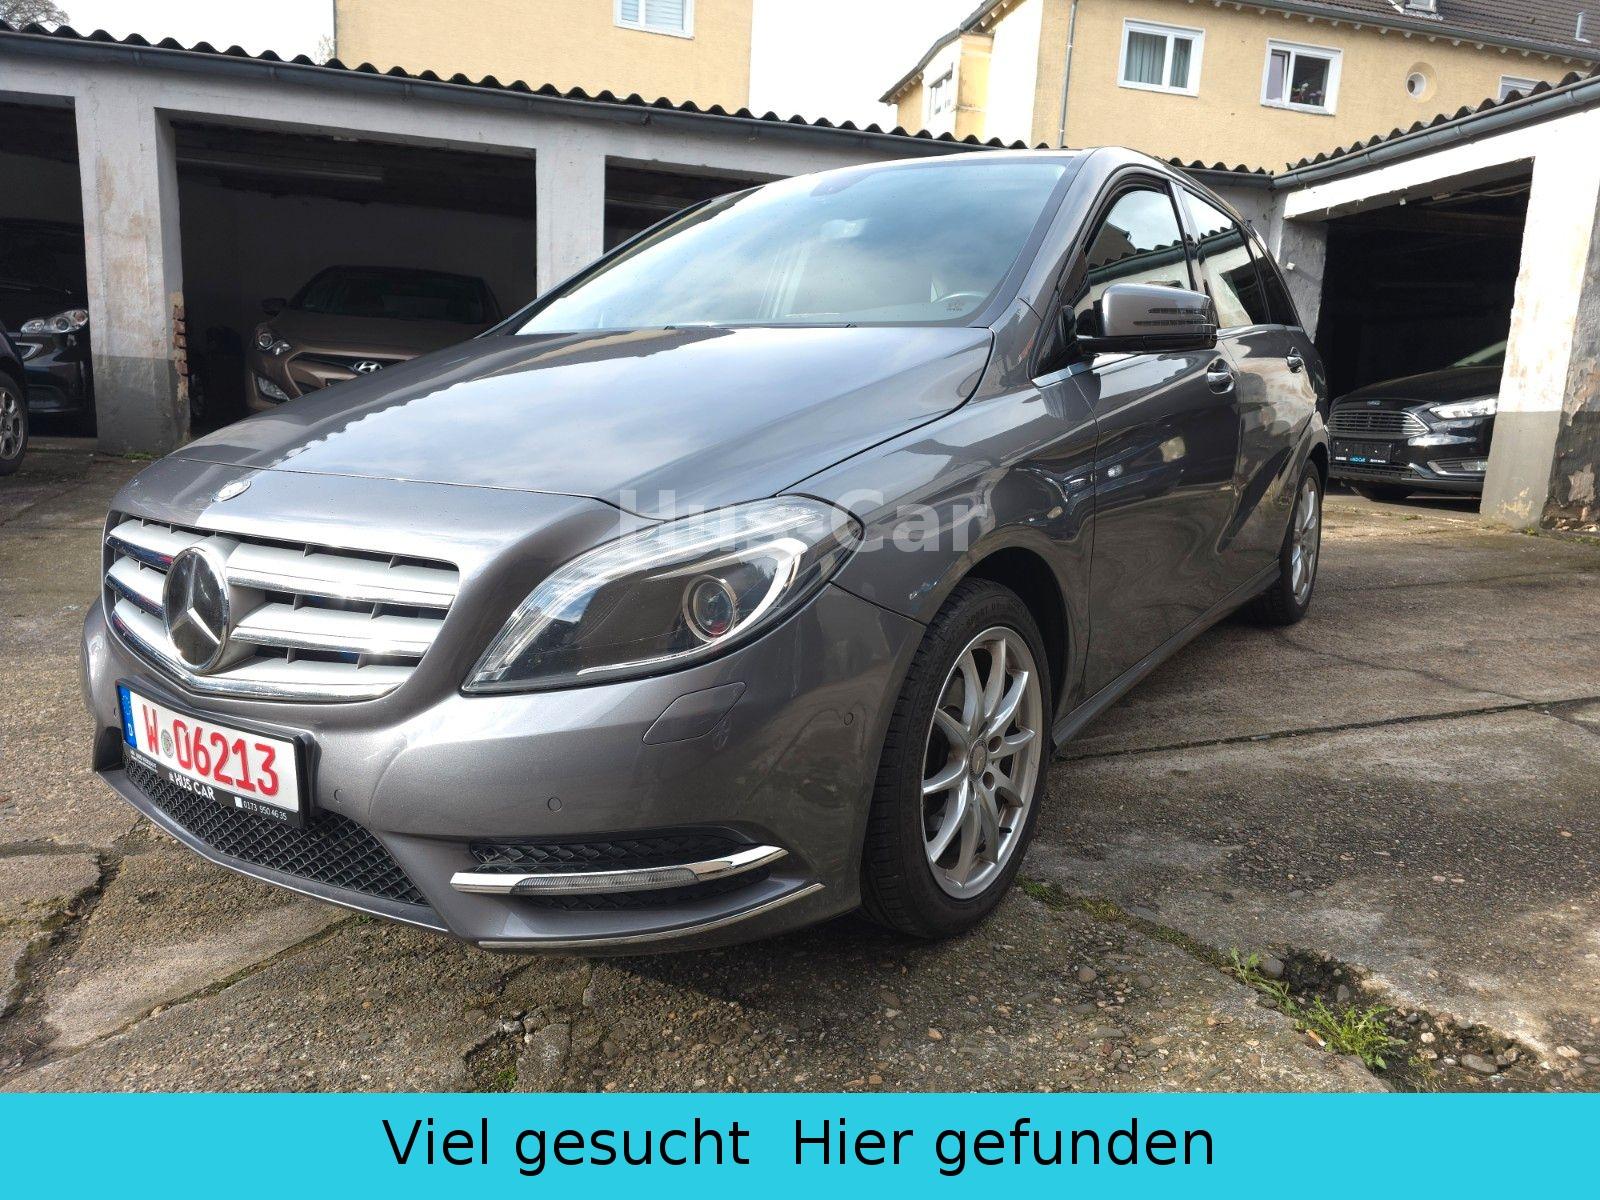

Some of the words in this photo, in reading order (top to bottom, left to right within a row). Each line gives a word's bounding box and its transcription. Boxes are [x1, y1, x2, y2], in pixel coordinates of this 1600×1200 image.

[142, 703, 160, 756] W
[172, 718, 280, 798] 06213
[193, 781, 216, 801] CAR
